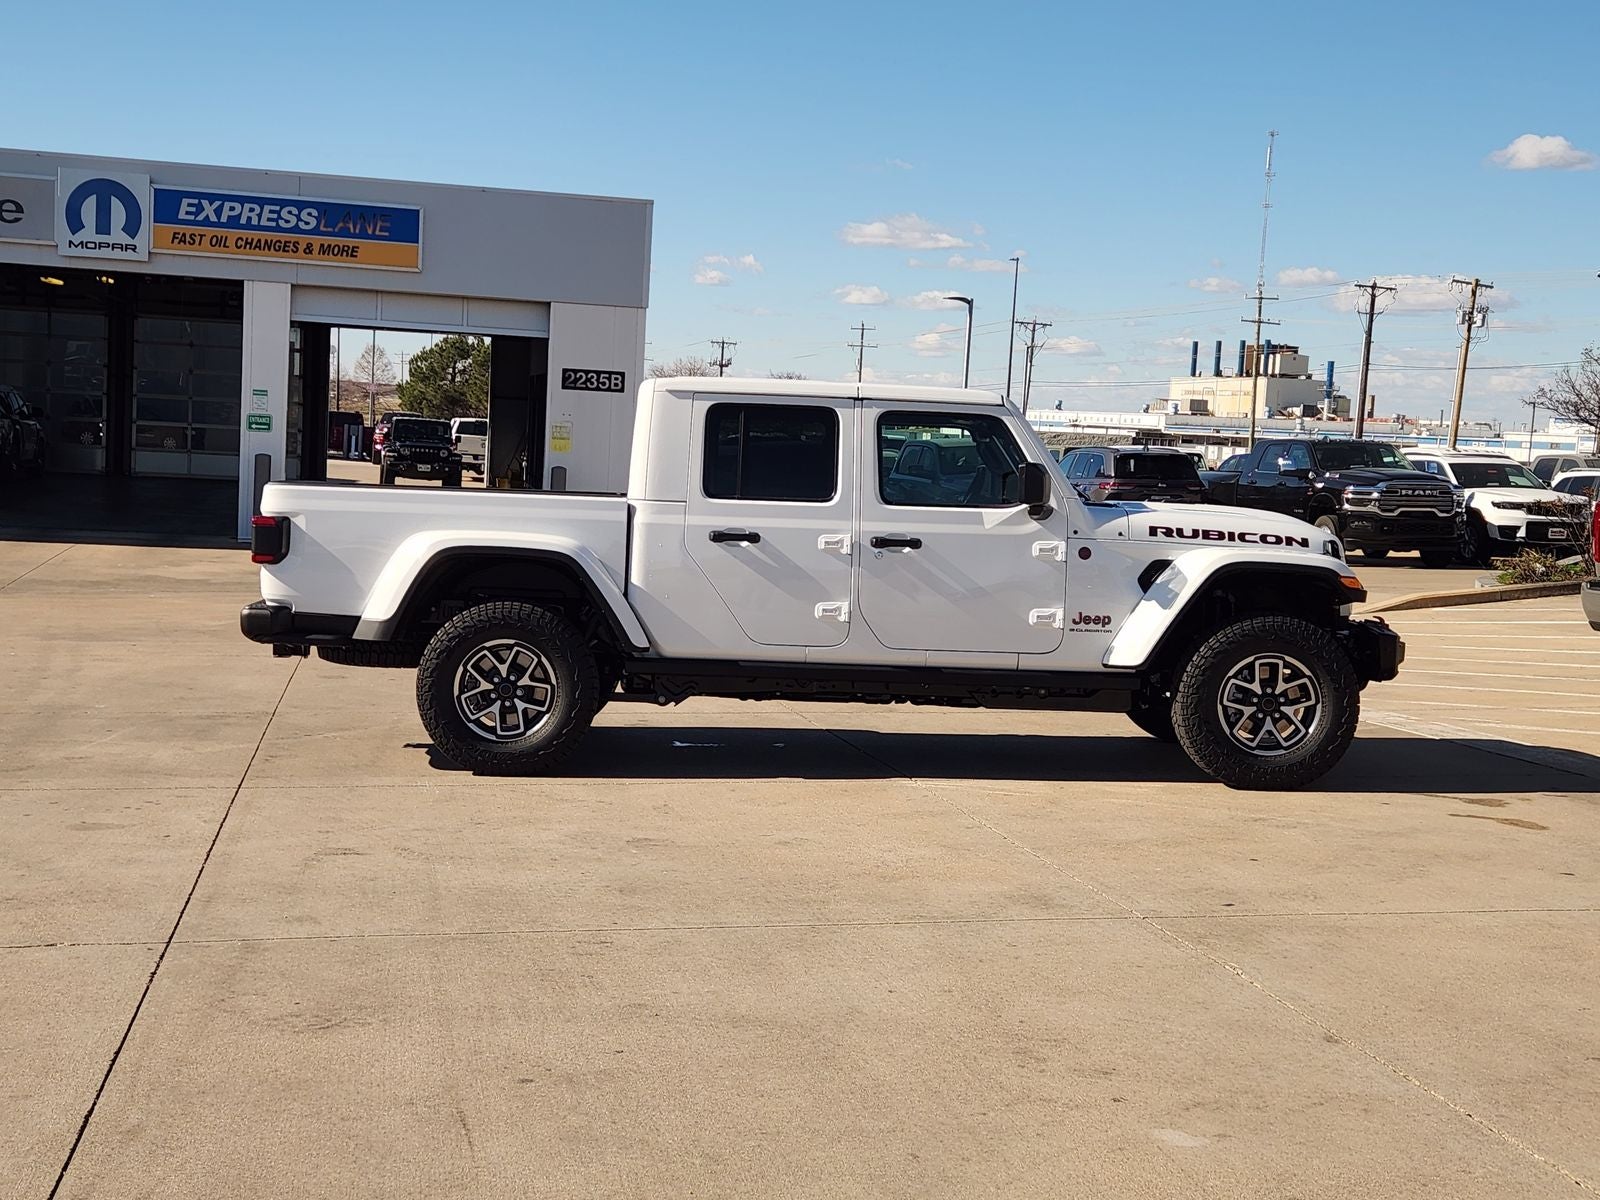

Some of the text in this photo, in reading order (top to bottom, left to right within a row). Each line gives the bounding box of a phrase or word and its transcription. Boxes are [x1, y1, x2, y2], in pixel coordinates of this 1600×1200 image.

[68, 239, 138, 254] MOPAR
[171, 231, 360, 258] FAST OIL CHANGES & MORE
[564, 371, 622, 390] 2235B
[1148, 525, 1310, 548] RUBICON
[1071, 611, 1112, 628] Jeep
